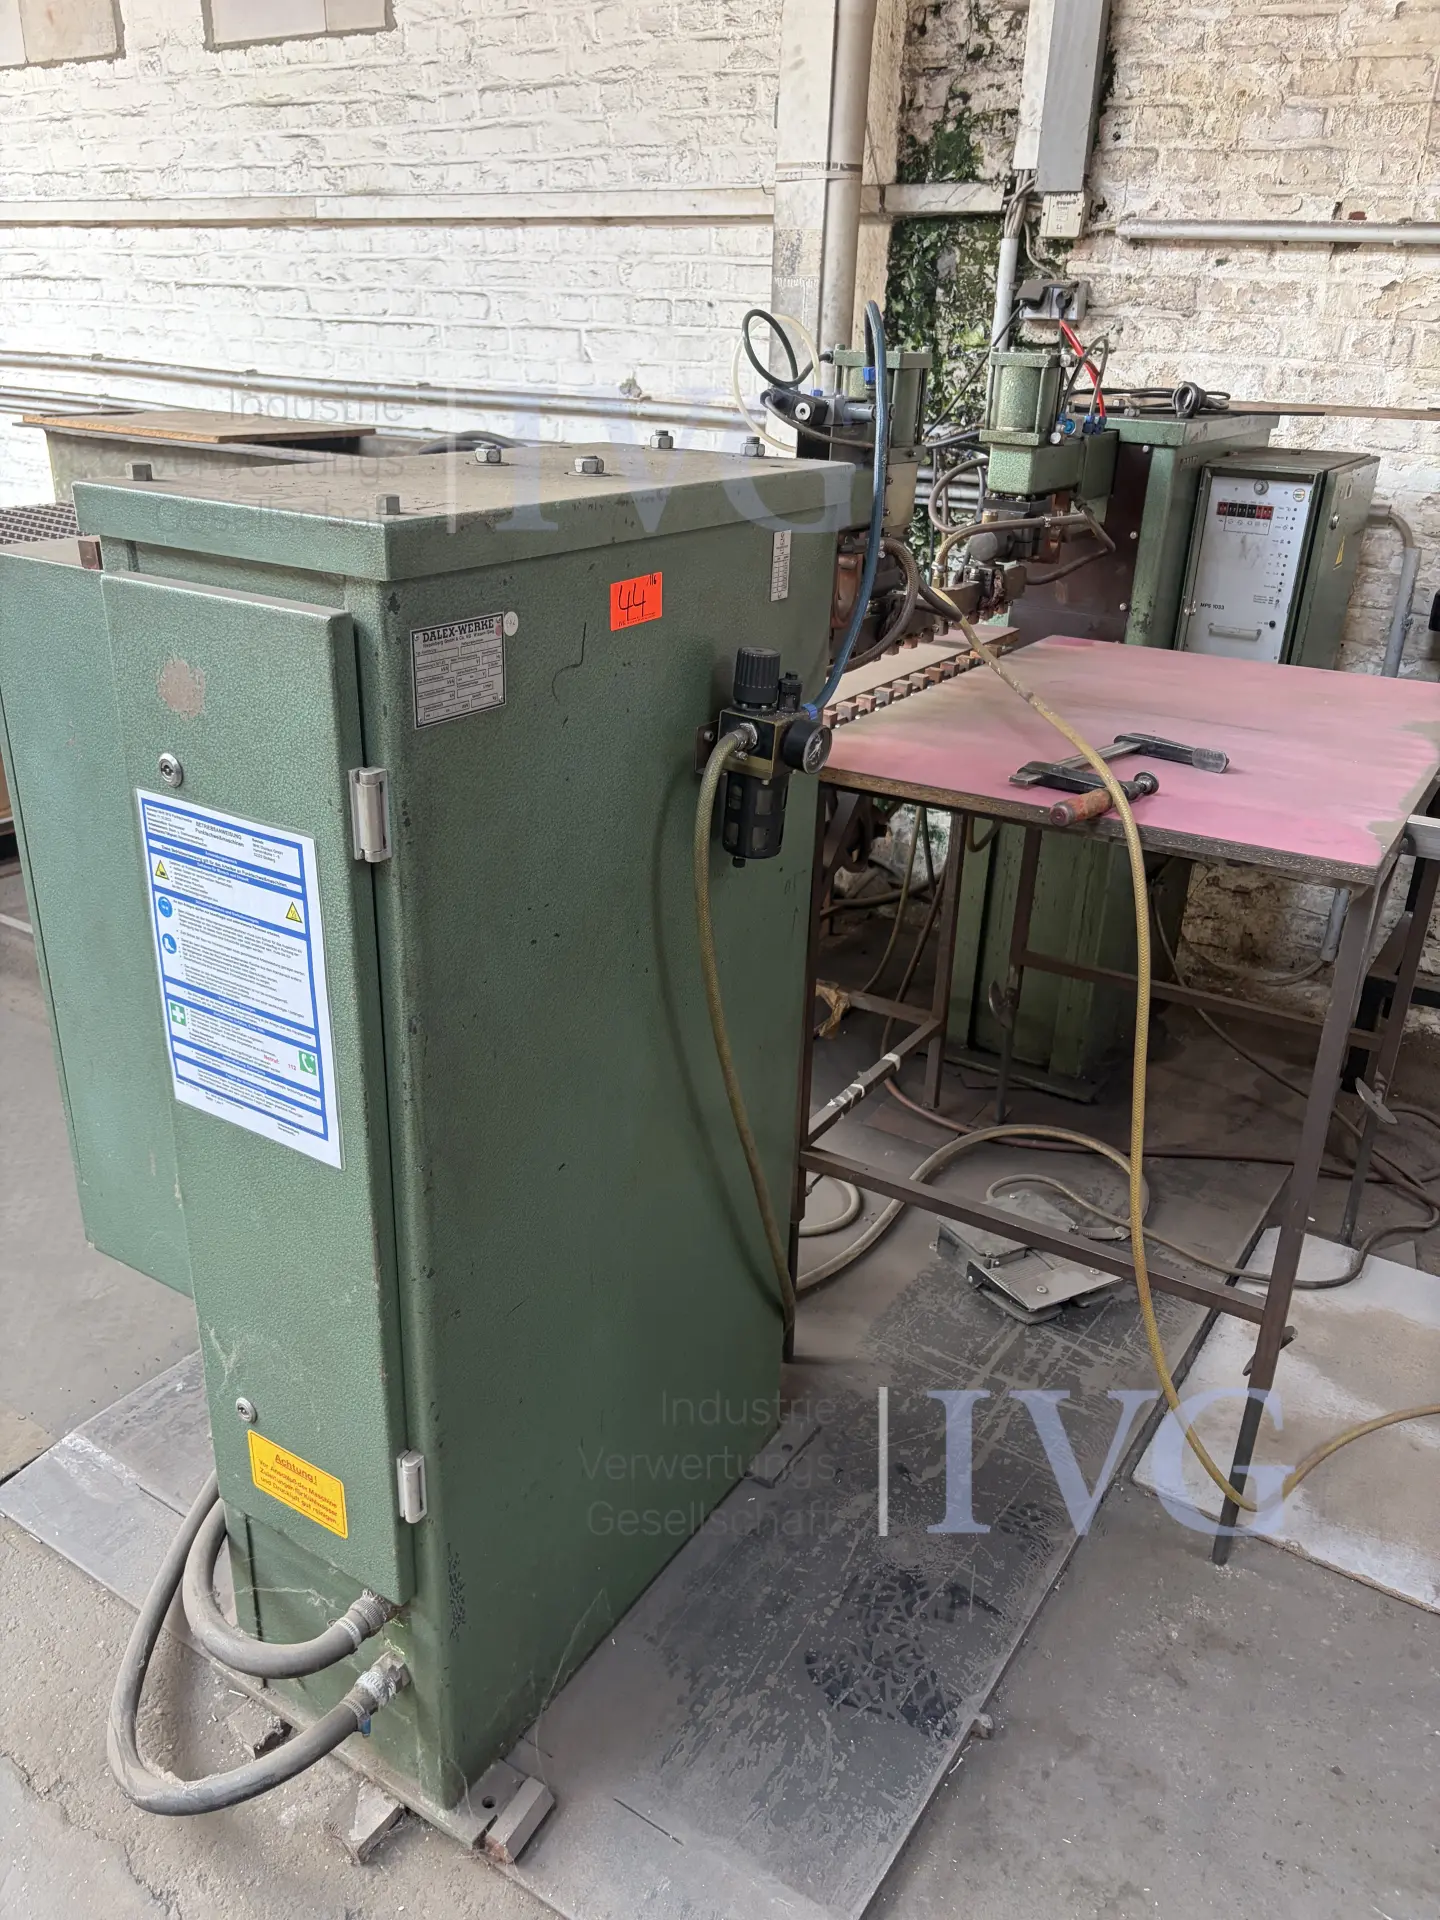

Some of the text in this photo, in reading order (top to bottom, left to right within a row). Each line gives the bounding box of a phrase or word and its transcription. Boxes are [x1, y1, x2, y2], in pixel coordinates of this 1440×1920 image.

[618, 583, 647, 621] 44
[422, 619, 494, 643] DALEX-WERKE
[274, 1453, 318, 1486] Achtung!
